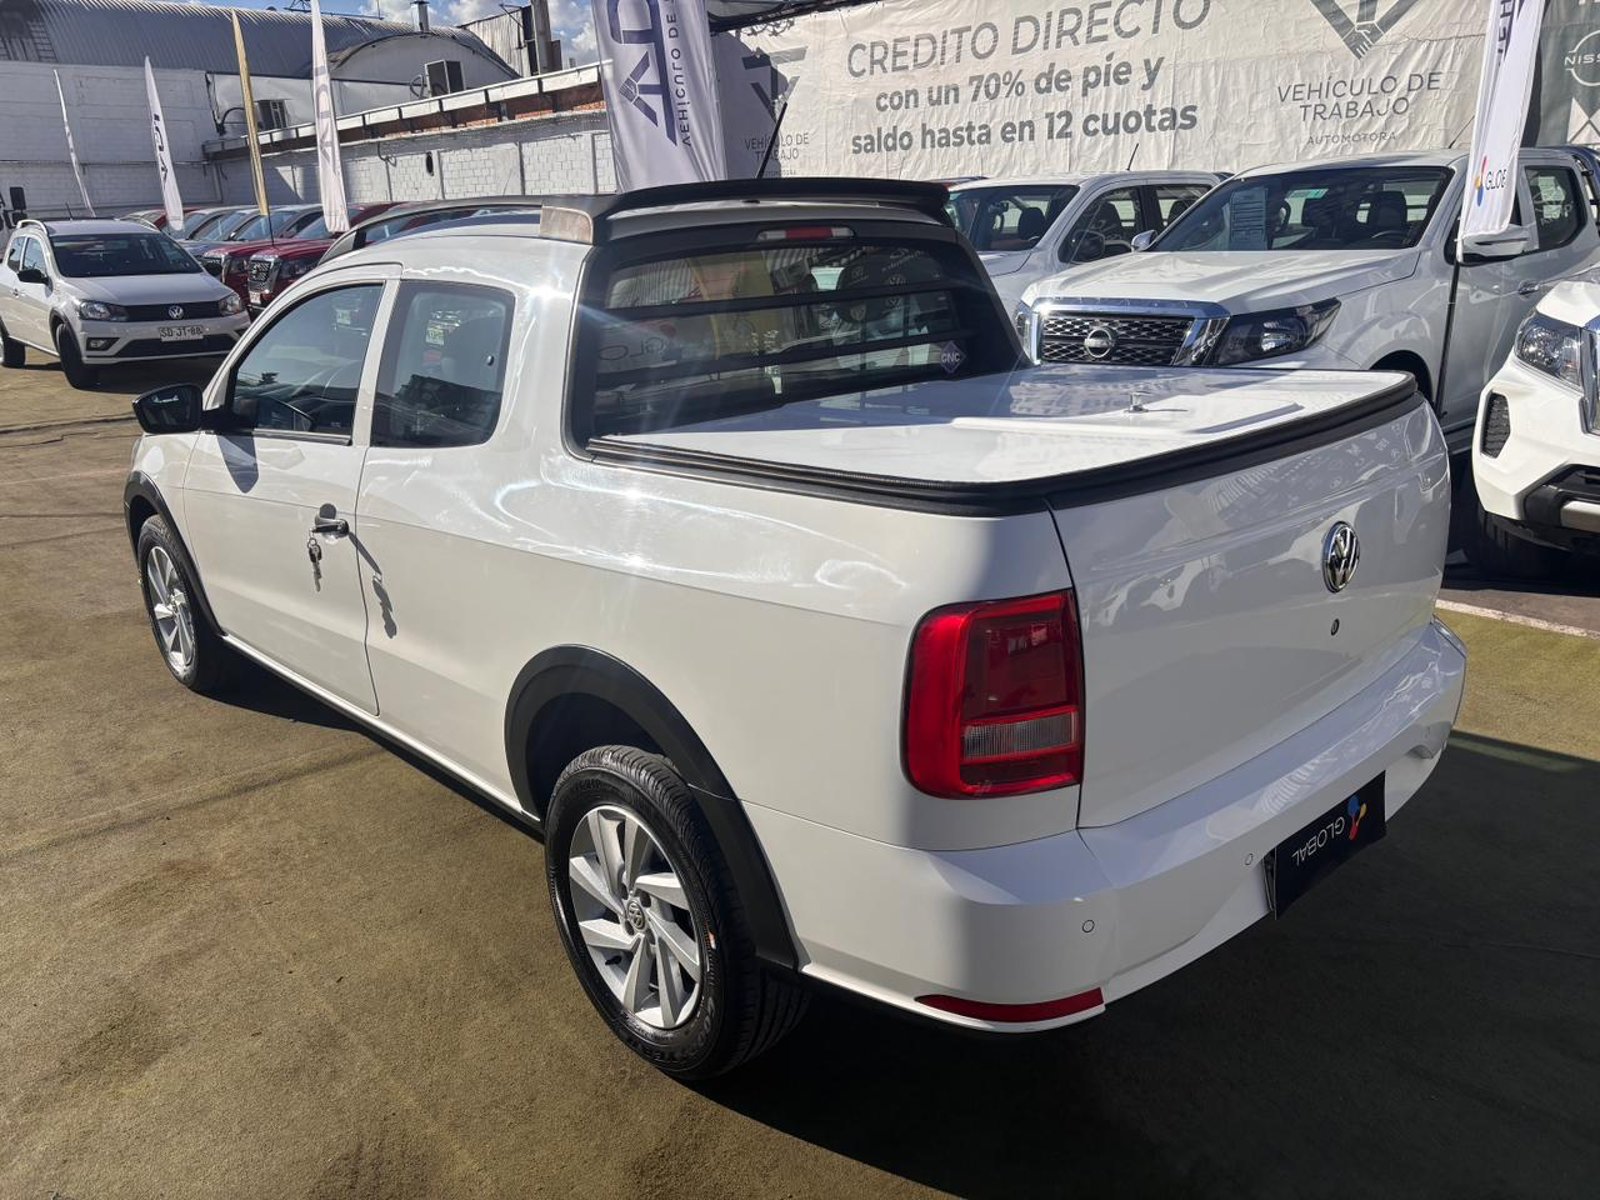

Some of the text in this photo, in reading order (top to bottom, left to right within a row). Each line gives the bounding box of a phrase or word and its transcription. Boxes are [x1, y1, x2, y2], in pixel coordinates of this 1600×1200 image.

[848, 0, 1211, 78] CREDITO DIRECTO
[876, 88, 919, 112] con
[927, 83, 960, 106] un
[969, 69, 1025, 102] 70%
[1034, 62, 1071, 95] de
[1141, 57, 1165, 90] y
[1278, 72, 1442, 102] VEHÍCULO DE
[852, 104, 1198, 154] saldo hasta en 12 cuotas
[1300, 97, 1410, 121] TRABAJO
[796, 132, 809, 147] DE
[1307, 131, 1396, 145] AUTOMOTORA
[1291, 816, 1346, 867] GLOBAL
